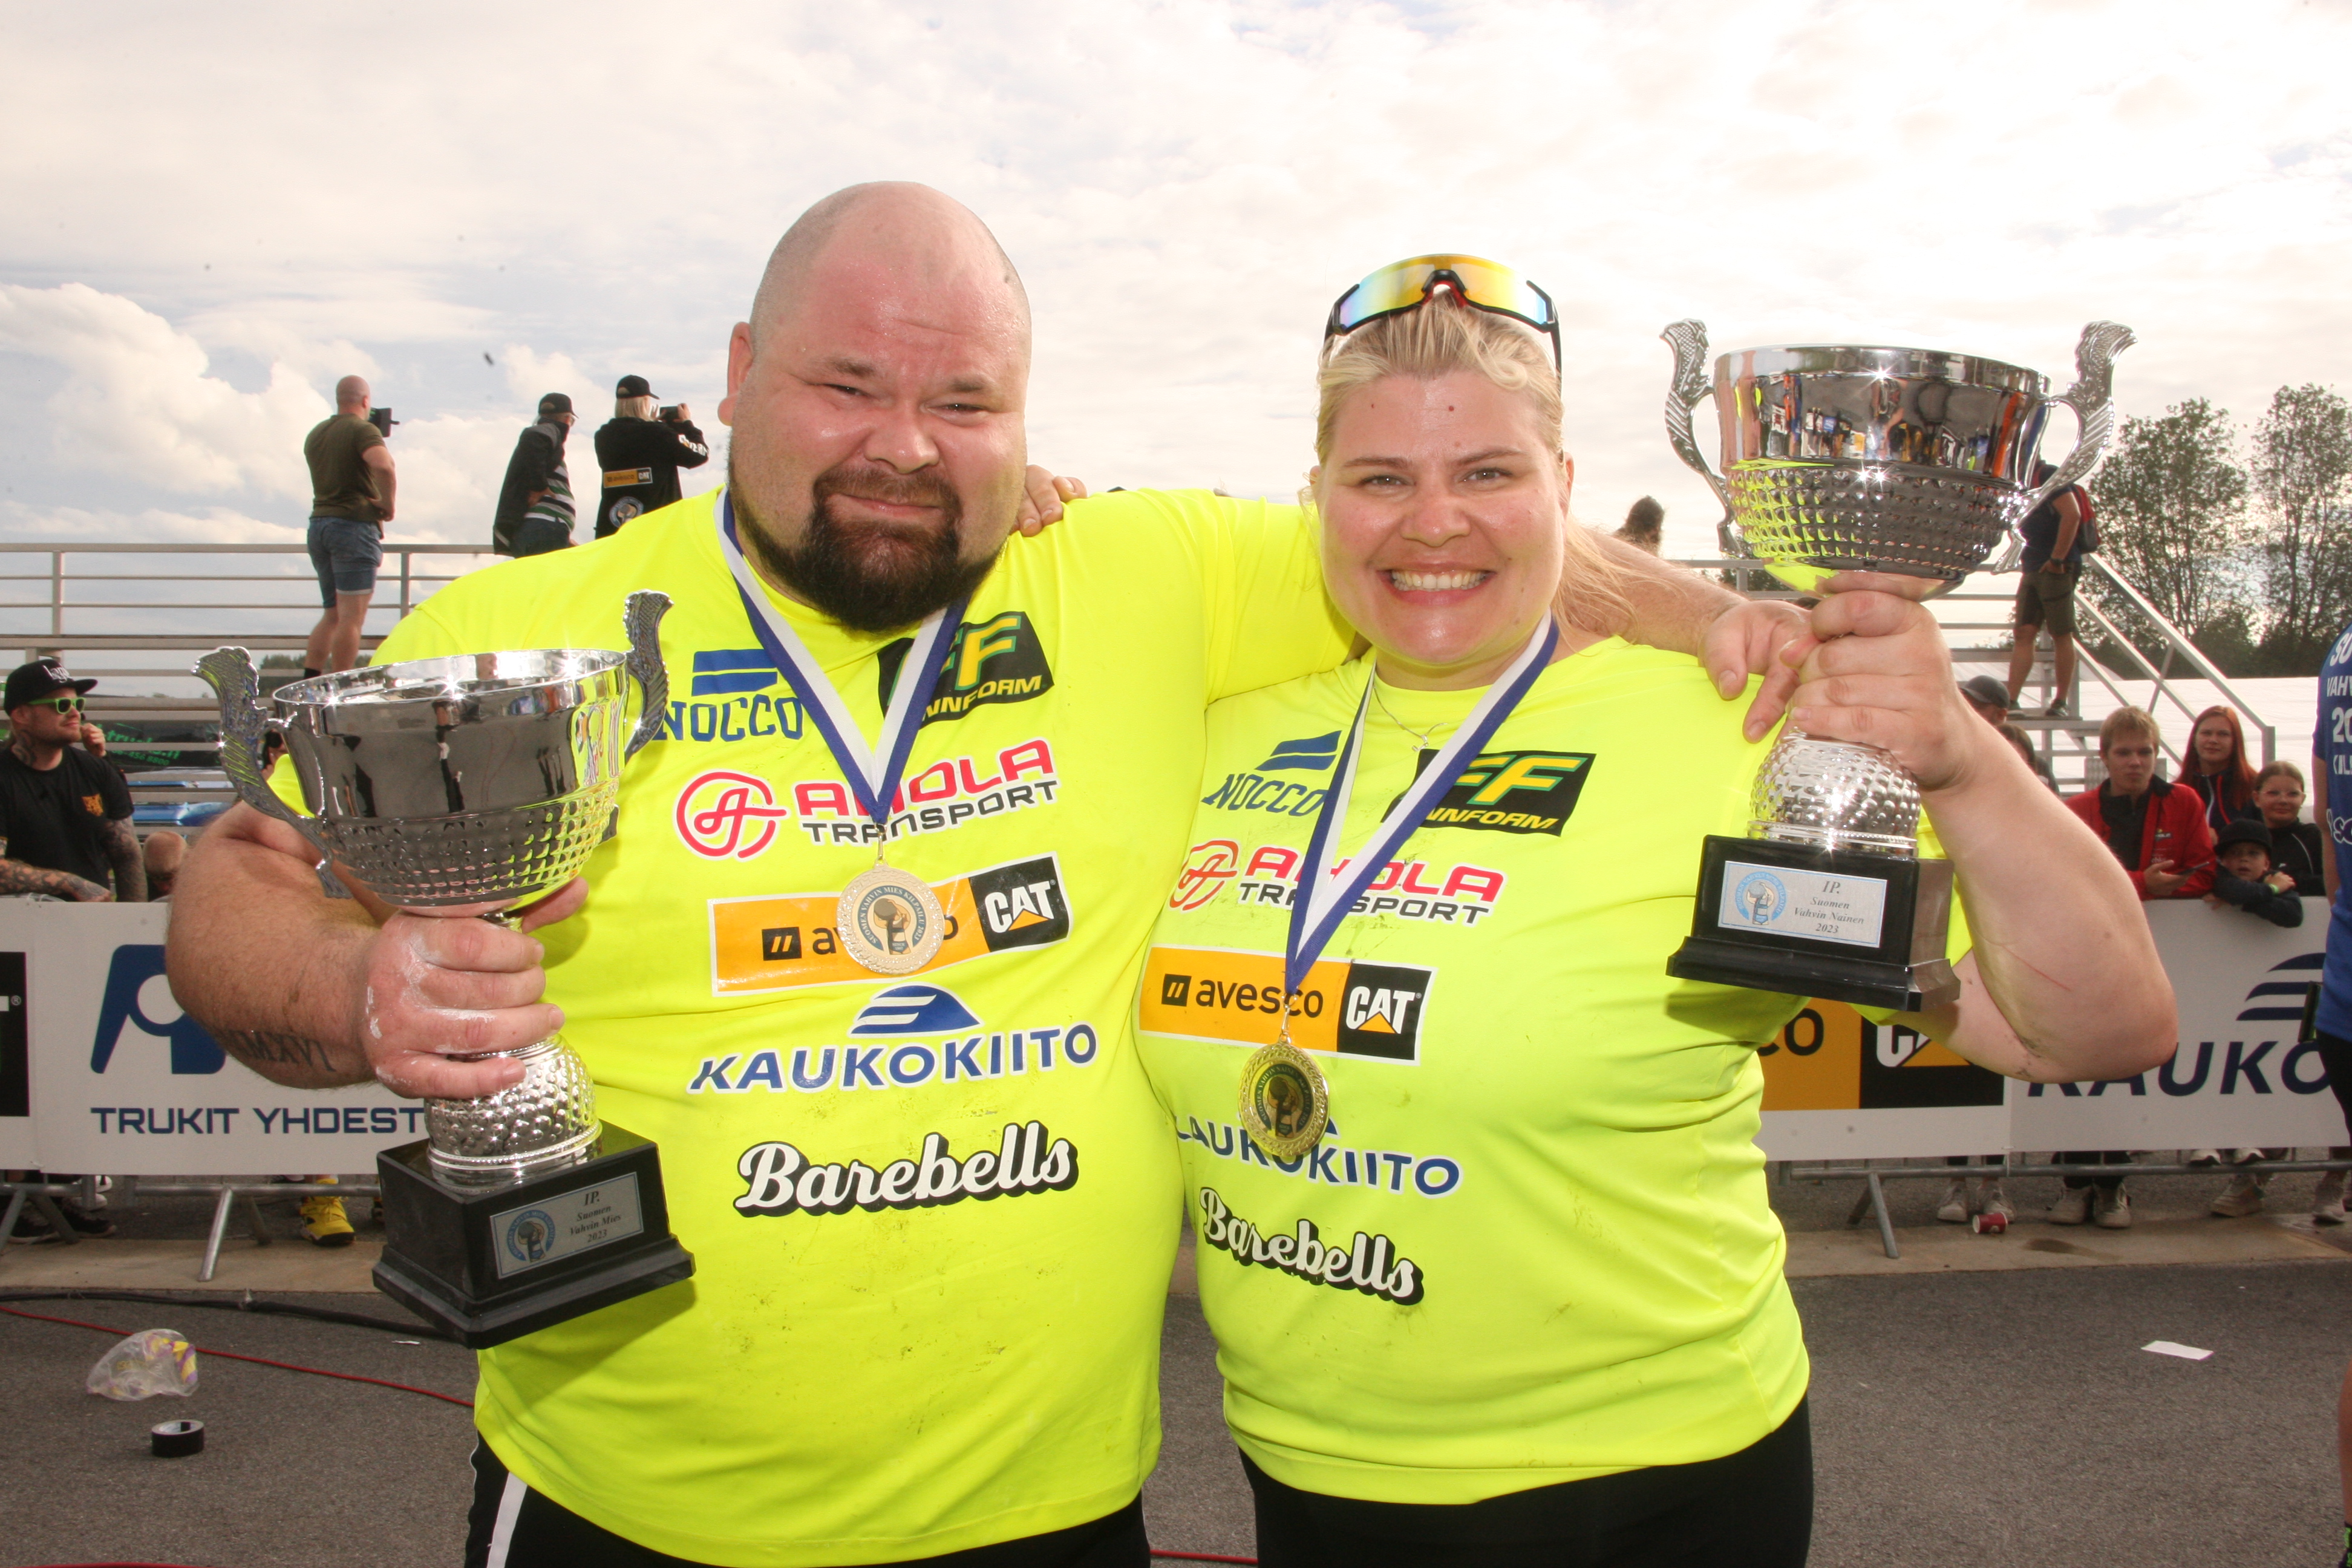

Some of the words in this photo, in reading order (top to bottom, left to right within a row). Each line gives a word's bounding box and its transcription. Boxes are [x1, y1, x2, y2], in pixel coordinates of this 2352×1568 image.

[1201, 773, 1329, 817] NOCCO
[883, 886, 904, 895] MIES
[1822, 880, 1841, 894] IP.
[861, 888, 883, 910] VAHVIN
[903, 891, 925, 924] KILPAILU
[985, 881, 1054, 933] CAT
[1810, 896, 1850, 909] Suomen
[1794, 907, 1826, 919] Vahvin
[1829, 912, 1864, 924] Nainen
[860, 912, 878, 944] SUOMEN
[1815, 923, 1839, 933] 2023
[1345, 985, 1415, 1034] CAT
[690, 1024, 1097, 1089] KAUKOKIITO
[91, 1107, 240, 1135] TRUKIT
[733, 1120, 1079, 1217] Barebells
[583, 1191, 600, 1206] IP.
[570, 1221, 599, 1236] Vahvin
[601, 1214, 621, 1226] Mies
[577, 1206, 612, 1222] Suomen
[587, 1229, 607, 1243] 2023
[1200, 1186, 1424, 1305] Barebells
